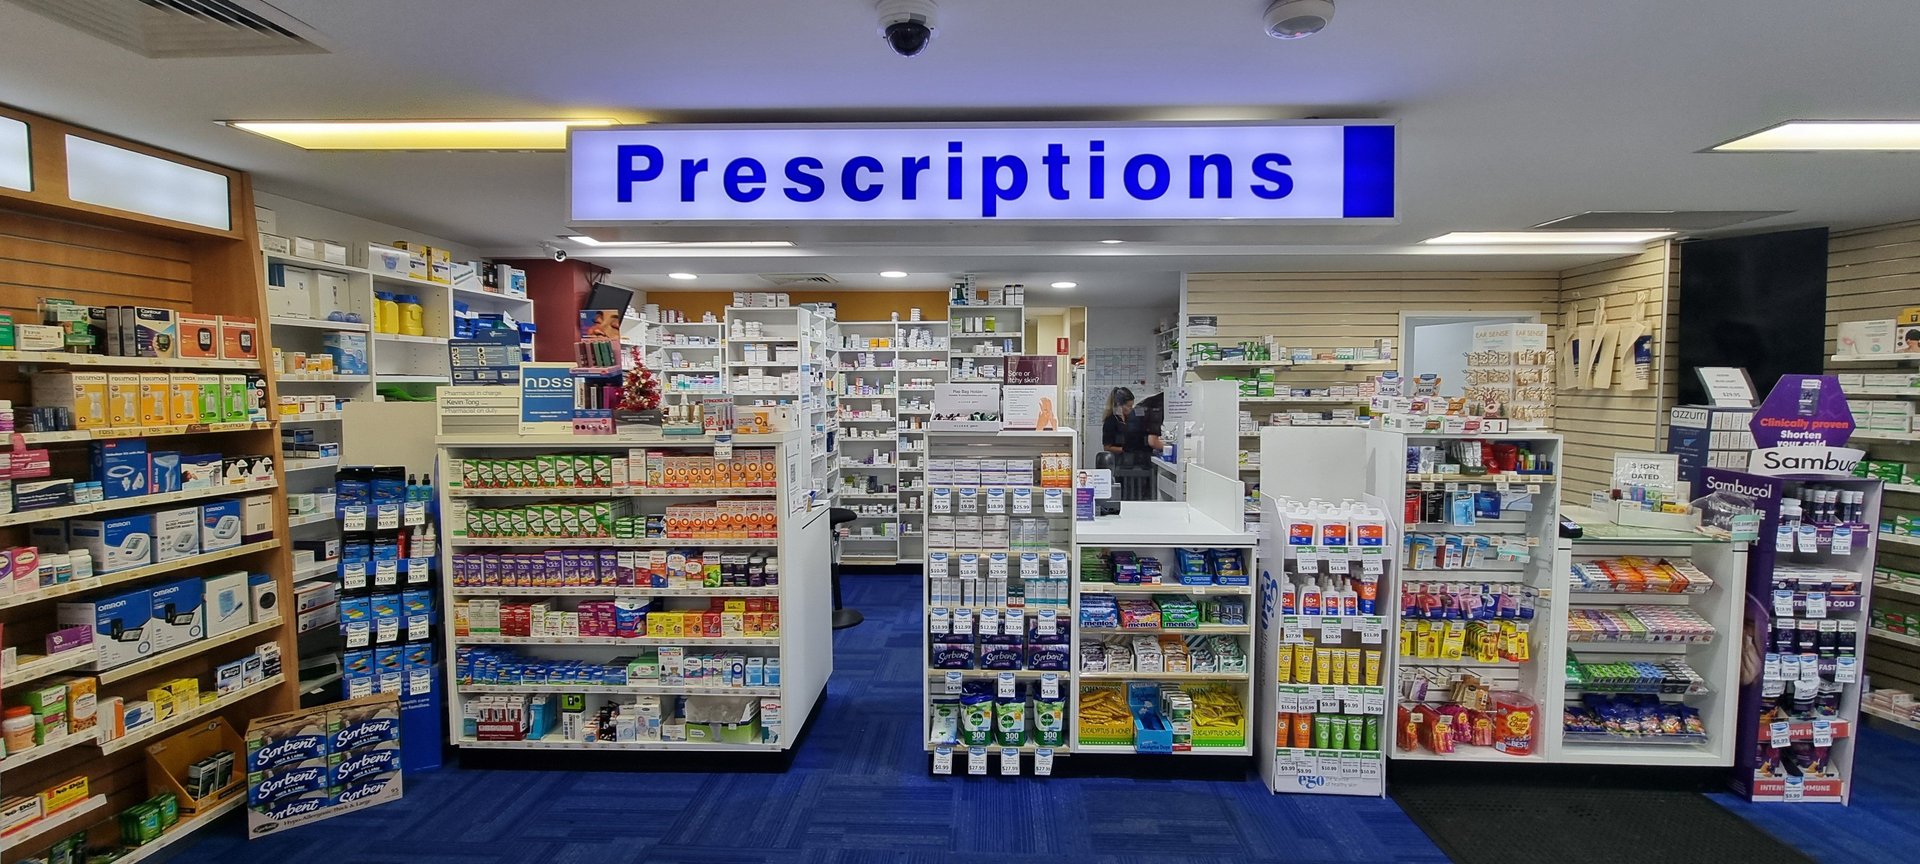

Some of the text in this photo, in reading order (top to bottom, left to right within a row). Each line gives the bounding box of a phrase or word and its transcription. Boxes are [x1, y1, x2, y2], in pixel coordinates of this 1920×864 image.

[615, 140, 1295, 218] Prescriptions
[1672, 409, 1706, 420] azzurri
[1760, 418, 1848, 429] Clinically proven
[1781, 430, 1822, 440] Shorten
[1707, 476, 1772, 498] Sambucol
[107, 520, 131, 529] OMRON
[153, 586, 179, 598] OMRON
[98, 600, 126, 611] OMRON
[938, 652, 969, 664] Sorbent
[986, 652, 1016, 664] Sorbent
[1033, 652, 1064, 665] Sorbent
[336, 720, 390, 748] Sorbent
[257, 736, 316, 766] Sorbent
[338, 751, 392, 780] Sorbent
[258, 768, 318, 799] Sorbent
[1298, 776, 1325, 789] ego
[339, 782, 384, 802] Sorben
